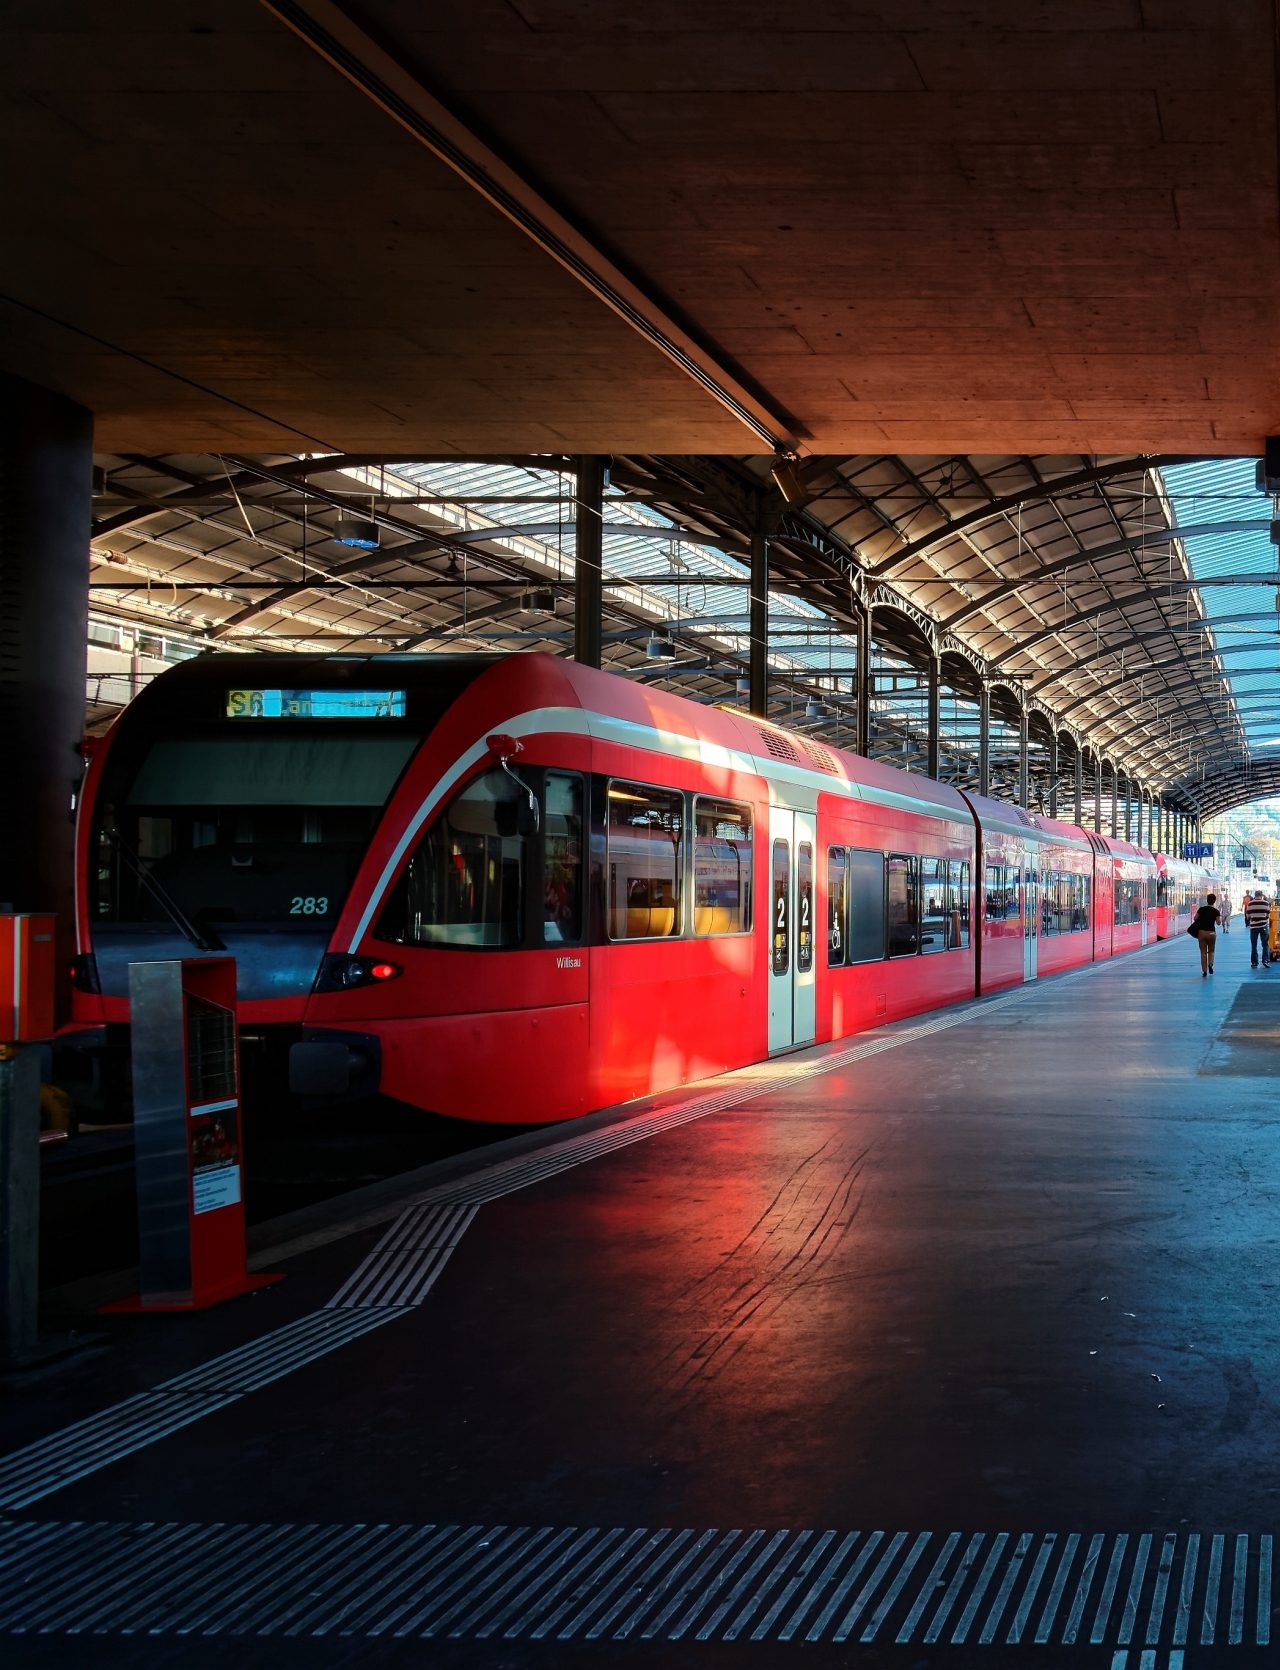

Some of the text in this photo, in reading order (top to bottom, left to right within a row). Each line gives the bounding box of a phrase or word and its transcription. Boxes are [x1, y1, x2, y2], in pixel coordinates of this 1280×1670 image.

[230, 691, 263, 714] S6
[1187, 847, 1210, 856] 11 A
[289, 896, 328, 914] 283
[777, 897, 785, 928] 2
[802, 897, 809, 926] 2
[556, 956, 582, 969] Willisau
